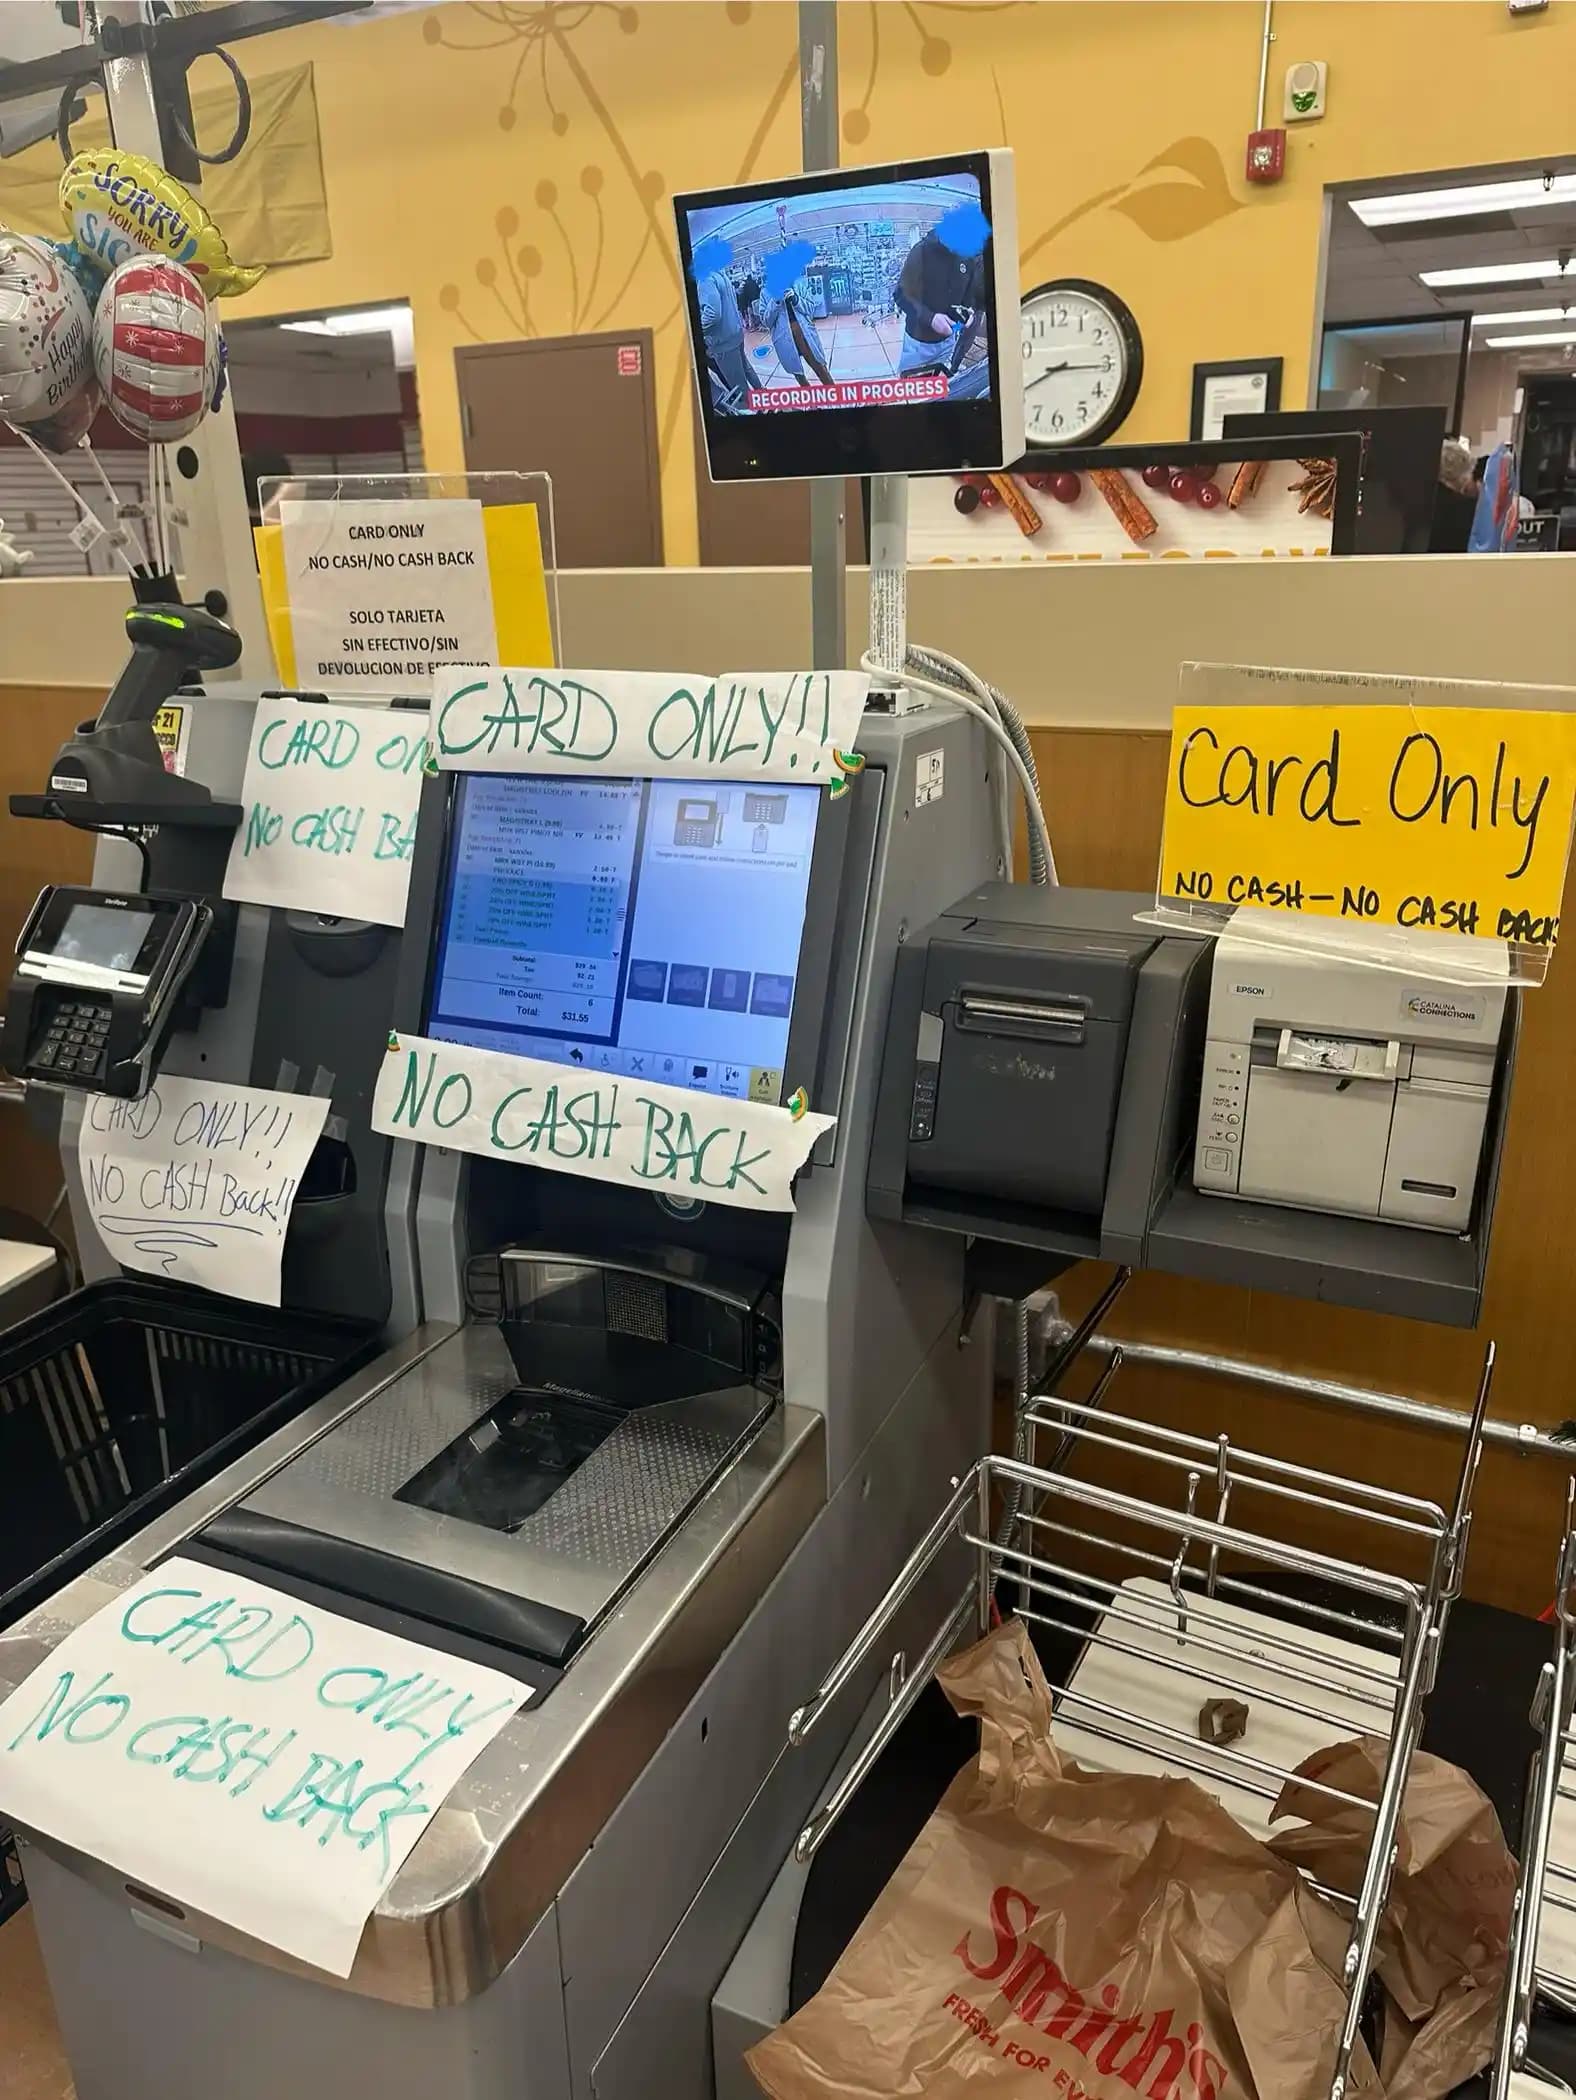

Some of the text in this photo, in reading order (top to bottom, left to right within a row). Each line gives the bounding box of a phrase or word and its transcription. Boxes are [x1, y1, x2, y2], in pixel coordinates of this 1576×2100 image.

[94, 163, 189, 249] SORRY
[108, 206, 159, 251] YOU ARE
[1050, 309, 1069, 328] 12
[1030, 320, 1045, 339] 11
[1093, 328, 1103, 346] 2
[48, 312, 84, 373] Happy
[1021, 340, 1033, 359] 0
[1101, 354, 1112, 373] 3
[751, 379, 944, 408] RECORDING IN PROGRESS
[1091, 381, 1104, 399] 4
[1032, 404, 1043, 422] 7
[1051, 408, 1064, 428] 6
[1077, 401, 1088, 423] 5
[349, 523, 424, 540] CARD ONLY
[309, 551, 475, 570] NO CASH/NO CASH BACK
[349, 609, 445, 624] SOLO TARJETA
[342, 636, 459, 654] SIN EFECTIVO/SIN
[318, 662, 402, 675] DEVOLUCION
[407, 662, 424, 675] DE
[162, 712, 175, 729] 21
[438, 674, 830, 773] CARD ONLY!!
[259, 719, 360, 770] CARD
[1179, 727, 1550, 879] Card Only
[245, 802, 284, 857] NO
[292, 805, 364, 855] CASH
[1176, 871, 1213, 898] NO
[1398, 896, 1479, 934] CASH
[498, 987, 594, 1007] Item Count: 6
[1236, 985, 1265, 996] EPSON
[516, 1005, 590, 1023] Total: $31.55
[1420, 1001, 1456, 1011] CATALINA
[1420, 1007, 1476, 1020] CONNECTIONS
[91, 1088, 292, 1170] CARD ONLY!!
[393, 1051, 770, 1195] NO CASH BACK
[89, 1153, 124, 1207] NO
[140, 1158, 212, 1211] CASH
[121, 1589, 513, 1784] CARD ONLY
[8, 1671, 430, 1885] NO CASH BACK
[952, 1886, 1228, 2100] Smith's
[942, 1993, 999, 2048] FRESH
[1002, 2042, 1051, 2073] FOR
